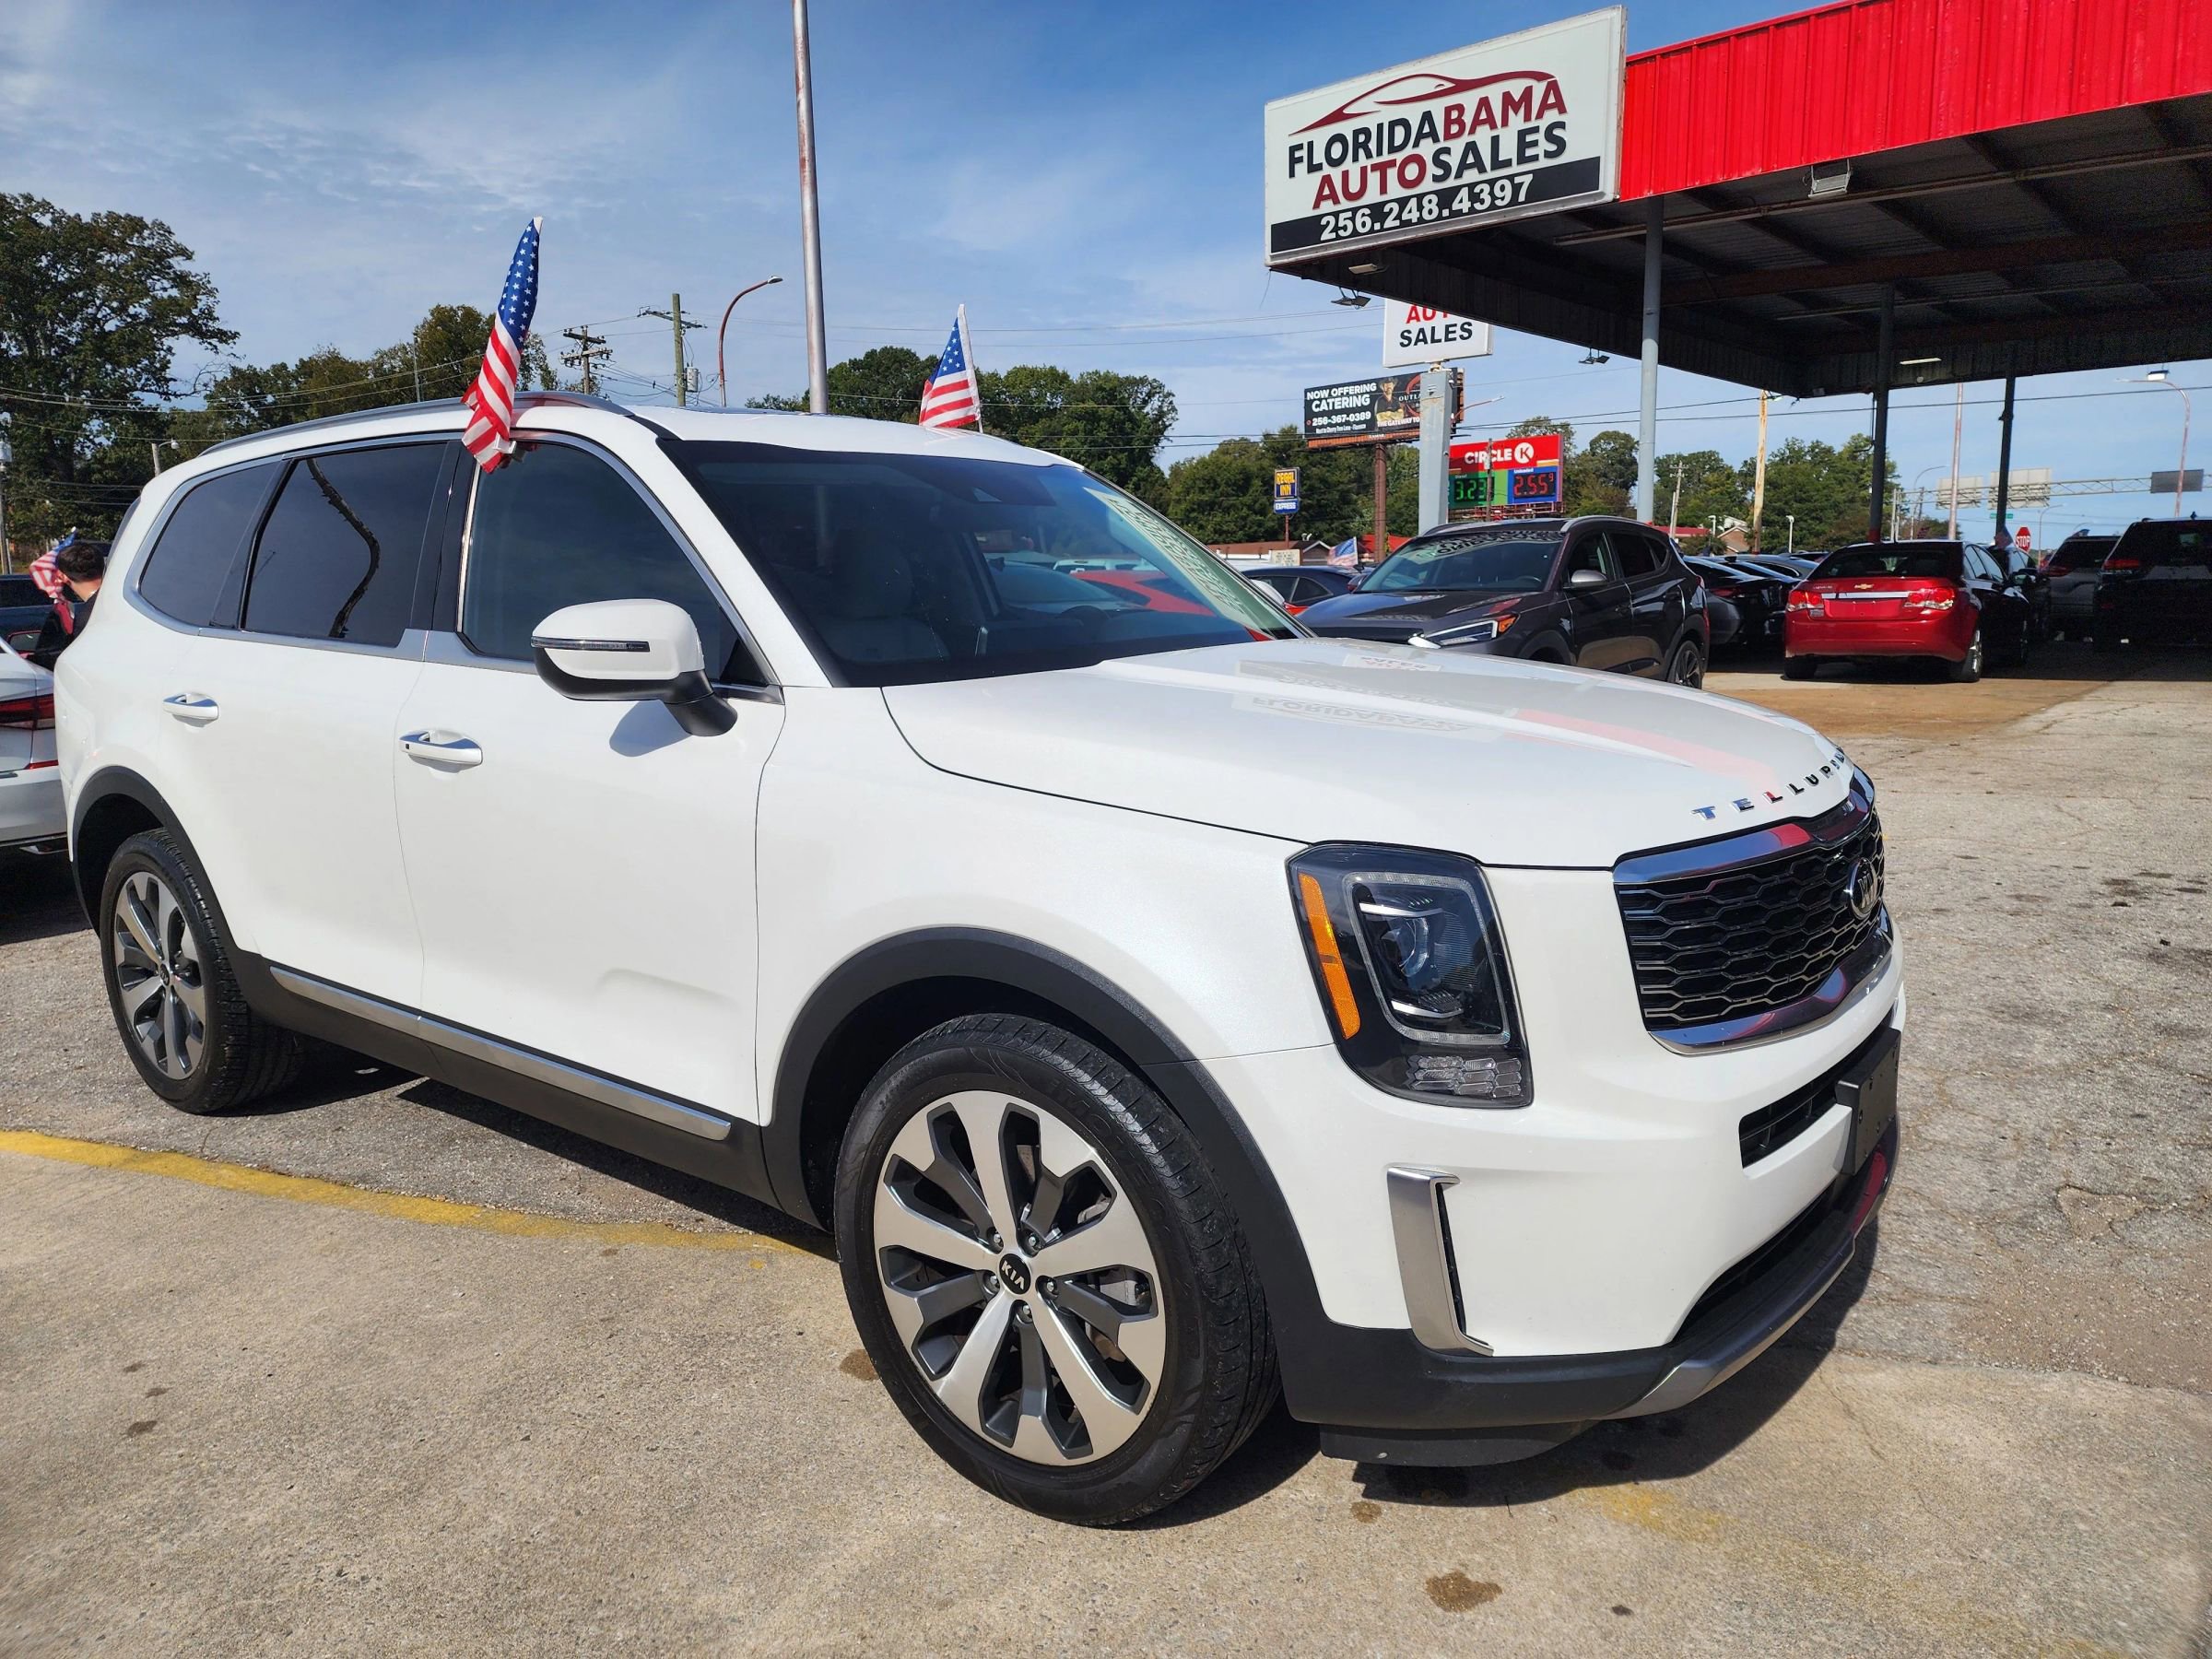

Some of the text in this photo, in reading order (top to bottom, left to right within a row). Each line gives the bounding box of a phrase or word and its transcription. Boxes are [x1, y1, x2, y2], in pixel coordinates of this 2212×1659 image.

[1319, 173, 1534, 241] 256.248.4397
[1399, 321, 1473, 348] SALES
[1306, 382, 1377, 401] NOW OFFERING
[1312, 394, 1371, 412] CATERING
[1312, 411, 1371, 427] 256-367-0389
[1465, 448, 1512, 465] CIRCLE
[1276, 472, 1295, 485] REGAL
[1280, 484, 1291, 496] INN
[2017, 535, 2030, 547] STOP
[1001, 1260, 1025, 1290] KIA
